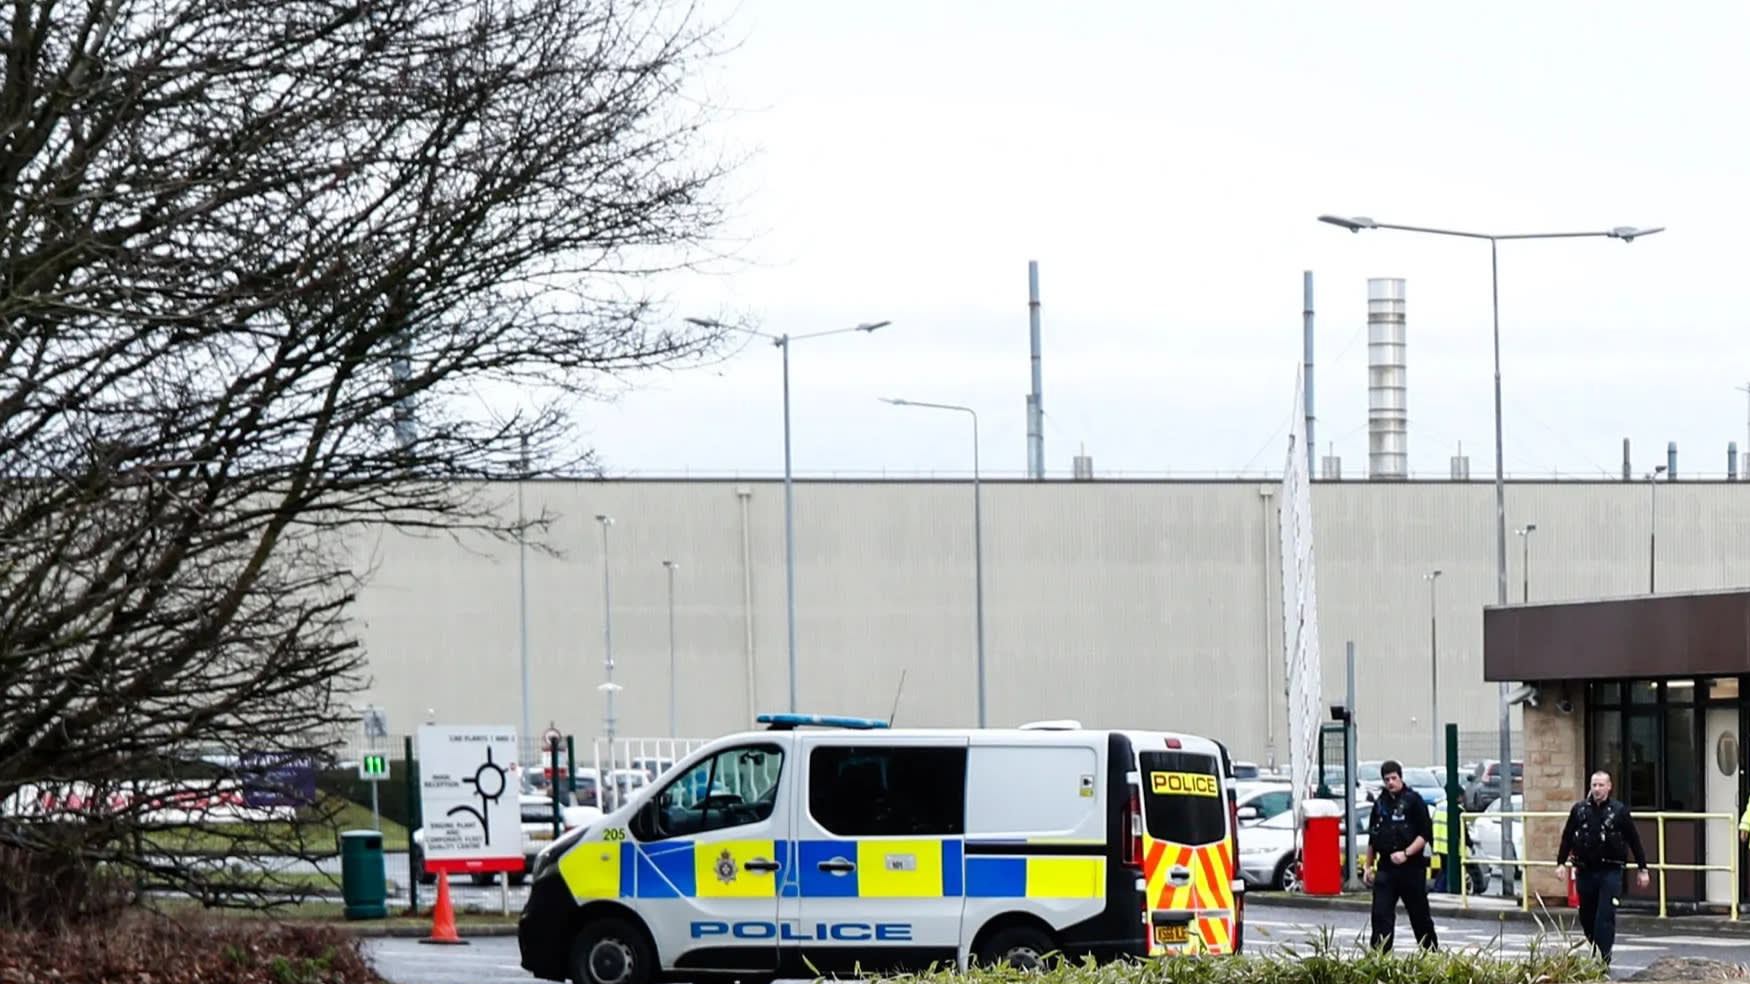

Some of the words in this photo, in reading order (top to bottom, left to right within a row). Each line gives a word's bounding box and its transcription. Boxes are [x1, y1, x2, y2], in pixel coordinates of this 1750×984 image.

[1154, 774, 1216, 793] POLICE
[603, 828, 625, 841] 205
[690, 921, 912, 941] POLICE
